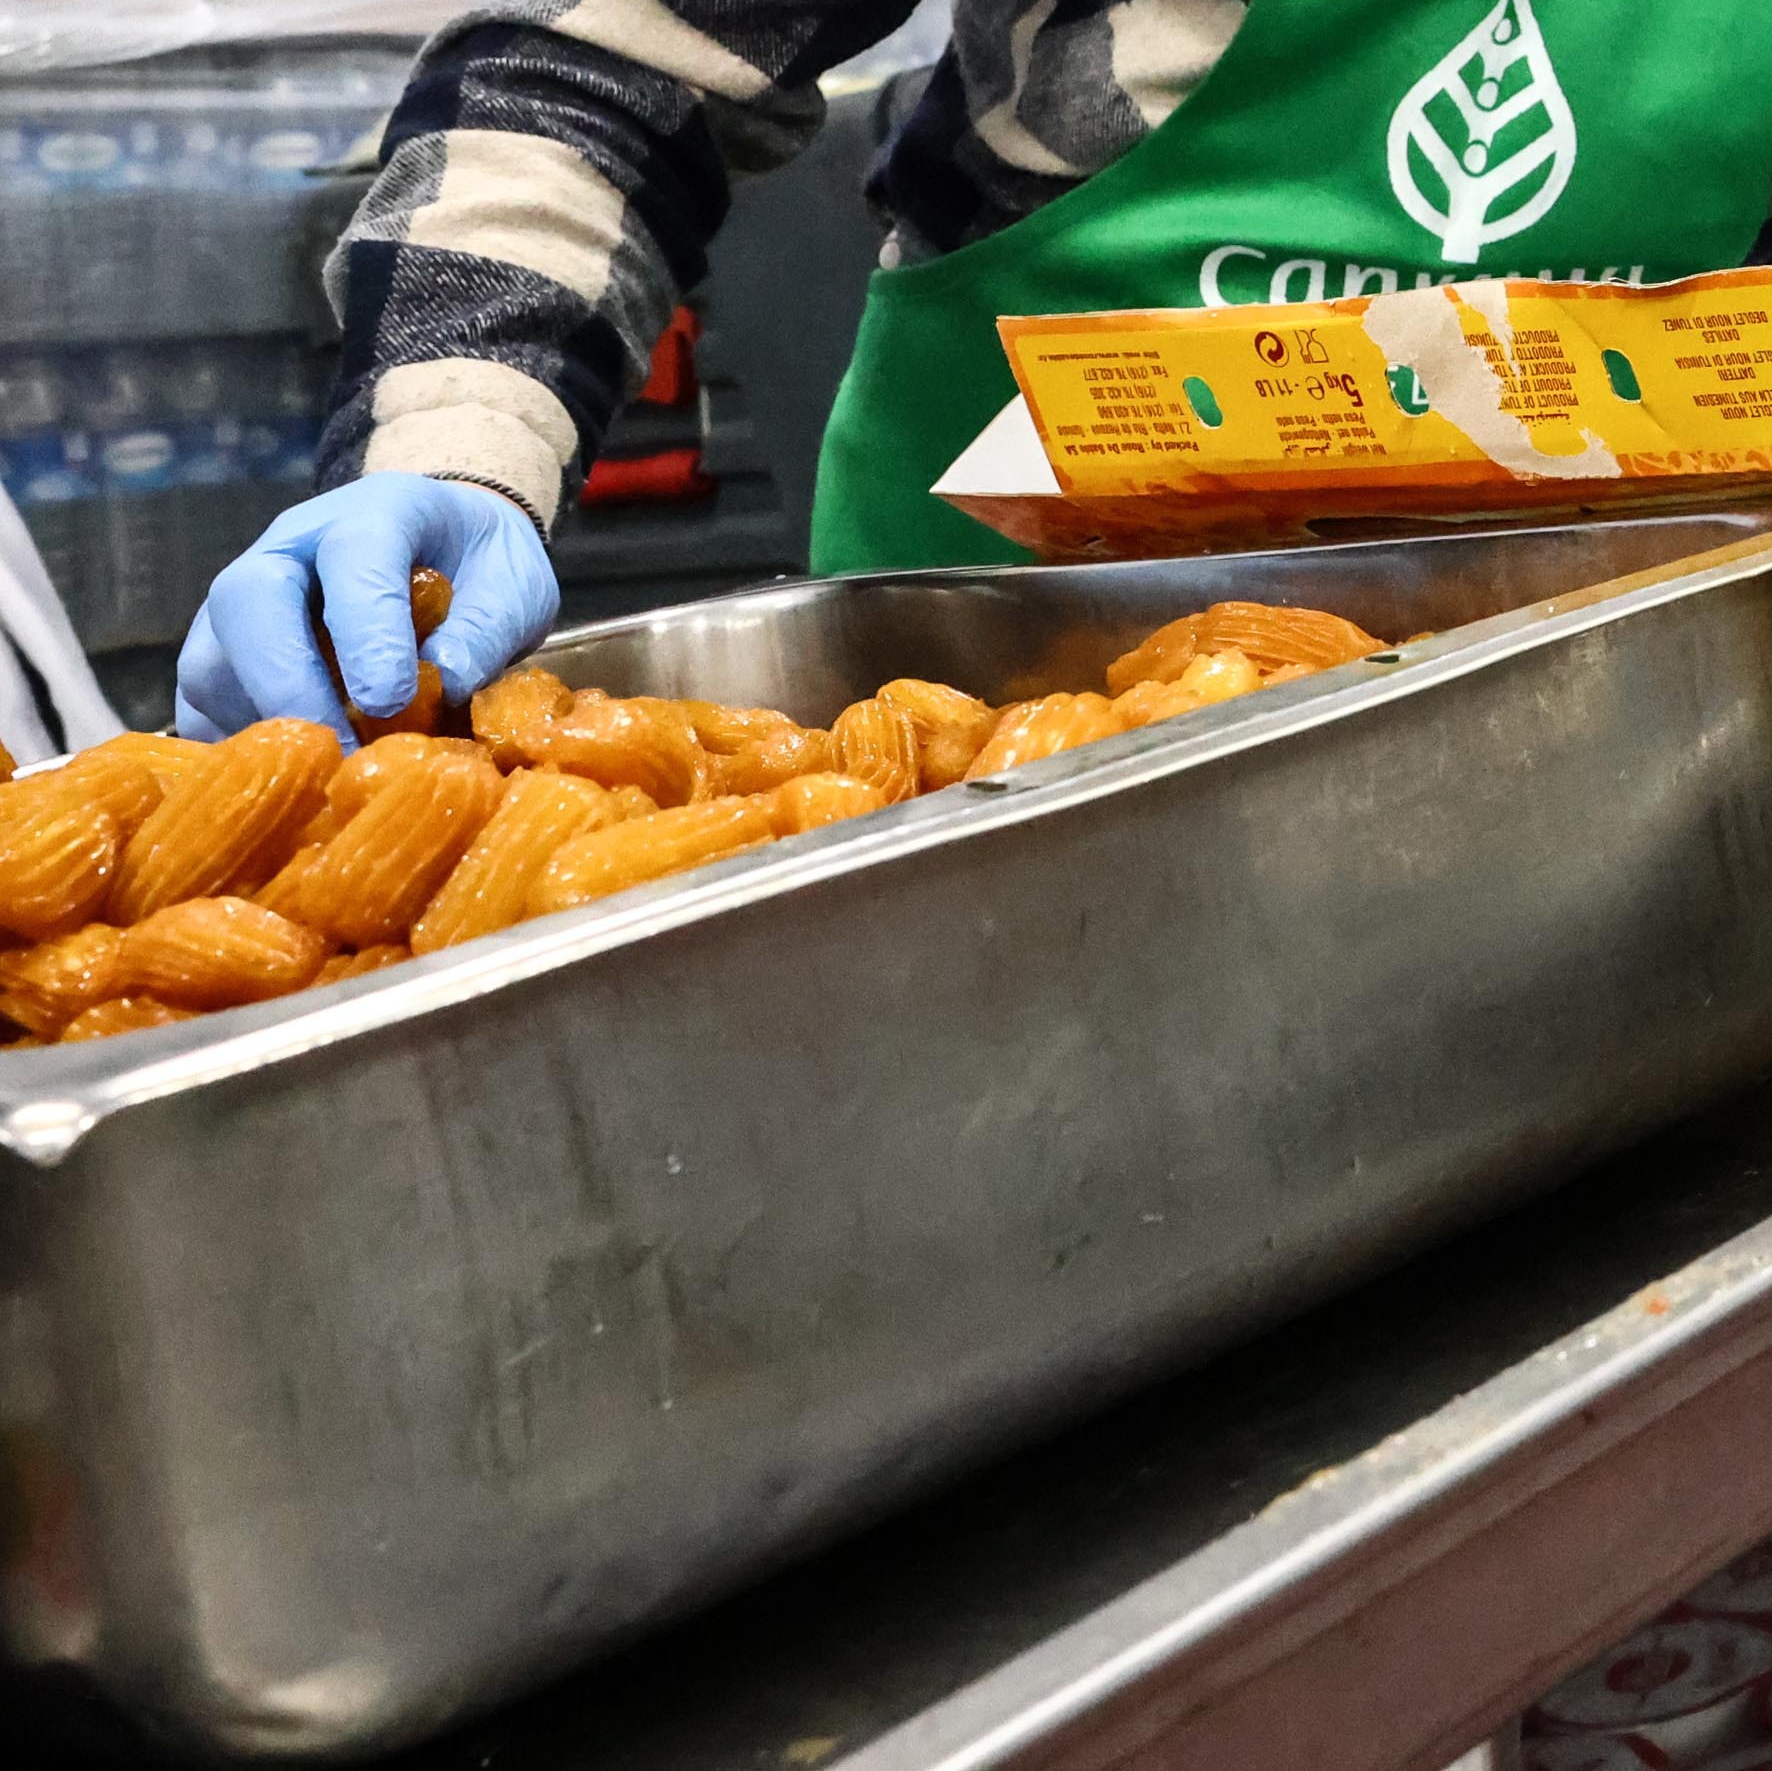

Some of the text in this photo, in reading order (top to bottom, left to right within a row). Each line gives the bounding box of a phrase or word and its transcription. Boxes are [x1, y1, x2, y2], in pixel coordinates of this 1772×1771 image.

[1662, 311, 1768, 331] DEGLET NOUR DI TUNEZ
[1701, 329, 1740, 343] DATILES
[1516, 346, 1564, 360] PRODOTTO
[1723, 352, 1751, 365] NOUR
[1674, 355, 1712, 369] TUNISIA
[1712, 355, 1722, 366] DI
[1528, 361, 1577, 375] PRODUCKT
[1717, 367, 1756, 381] DATTERI
[1254, 379, 1274, 398] LB
[1275, 378, 1293, 395] 11
[1519, 380, 1530, 392] OF
[1531, 378, 1572, 391] PRODUIT
[1523, 395, 1535, 409] OF
[1536, 393, 1579, 407] PRODUCT
[1692, 393, 1738, 407] TUNESIEN
[1738, 391, 1756, 403] AUS
[1344, 412, 1366, 424] Peso
[1720, 407, 1748, 419] NOUR
[1064, 445, 1079, 456] SA
[1106, 443, 1120, 454] De
[1121, 443, 1145, 454] Rose
[1150, 439, 1164, 453] by
[1164, 441, 1200, 452] Packed
